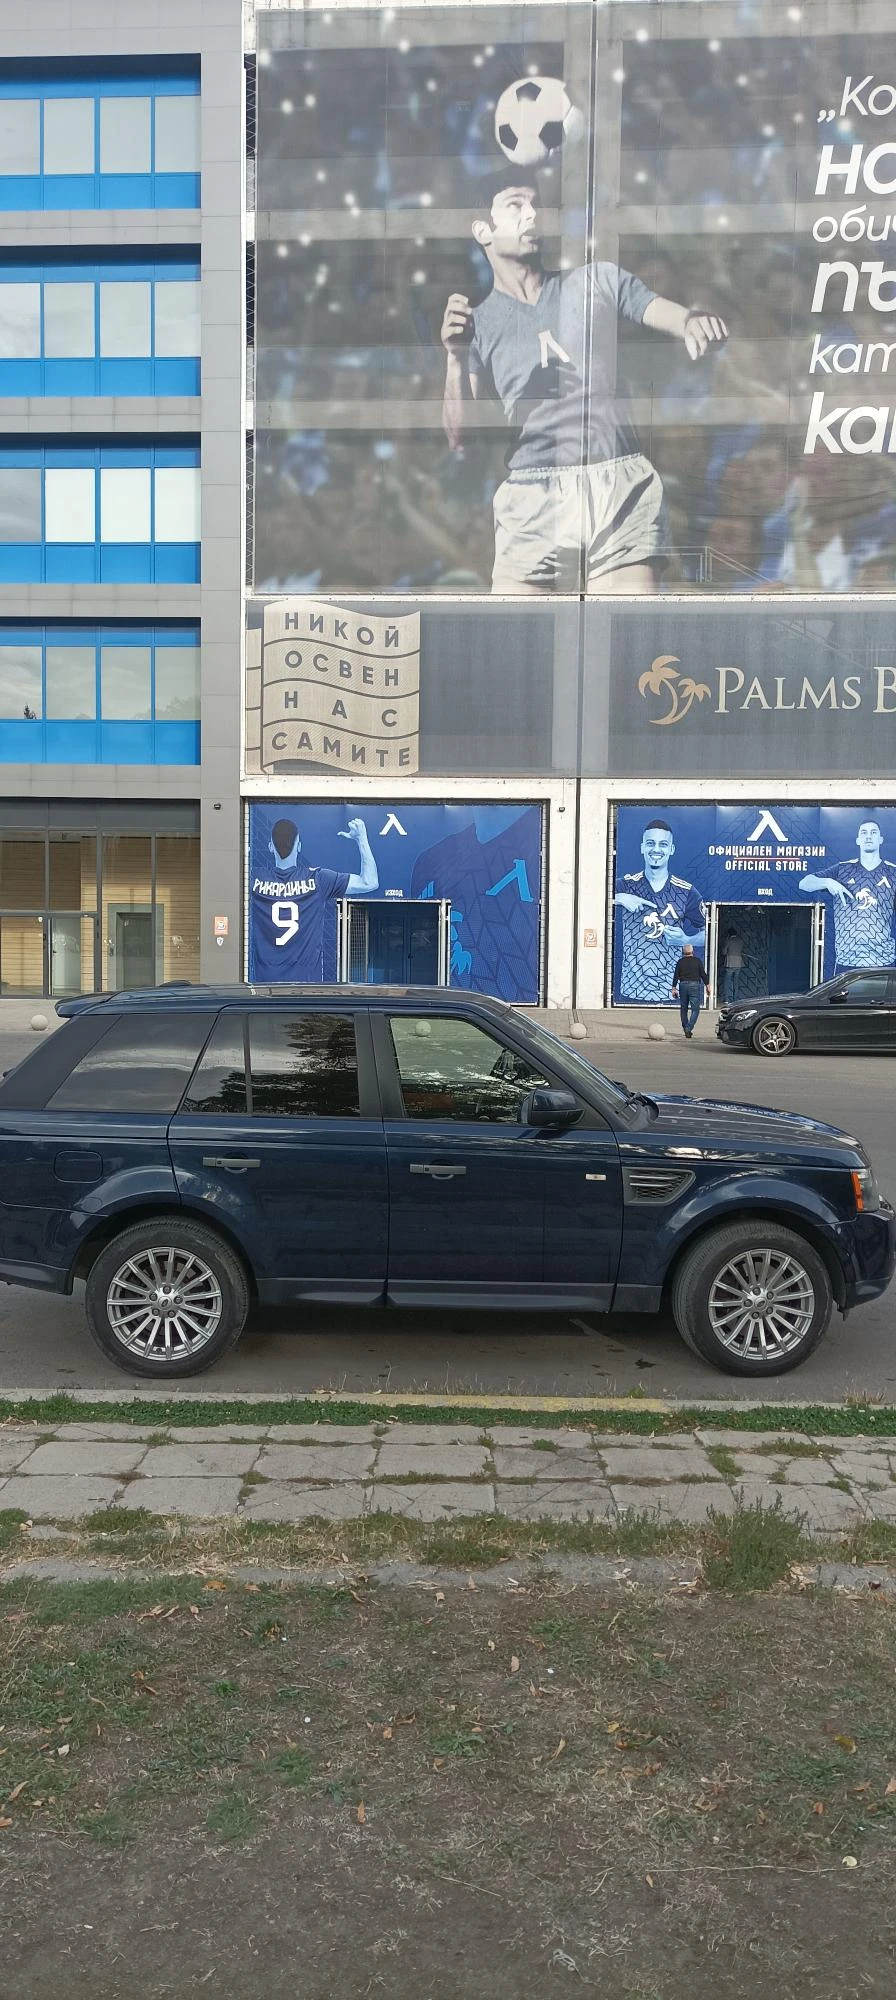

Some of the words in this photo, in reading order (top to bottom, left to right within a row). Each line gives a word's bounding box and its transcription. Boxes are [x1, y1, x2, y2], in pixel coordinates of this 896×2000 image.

[812, 204, 896, 243] оби
[803, 391, 896, 455] ка
[285, 612, 399, 648] НИКОЙ
[285, 650, 399, 687] ОСВЕН
[714, 666, 862, 713] PALMS
[284, 691, 398, 728] НАС
[271, 732, 411, 768] САМИТЕ
[708, 845, 772, 858] ОФИЦИАЛЕН
[776, 846, 826, 857] МАГАЗИН
[725, 860, 771, 871] OFFICIAL
[775, 860, 808, 871] STORE
[252, 878, 316, 898] РИКАРДИНЬО
[271, 901, 299, 946] 9
